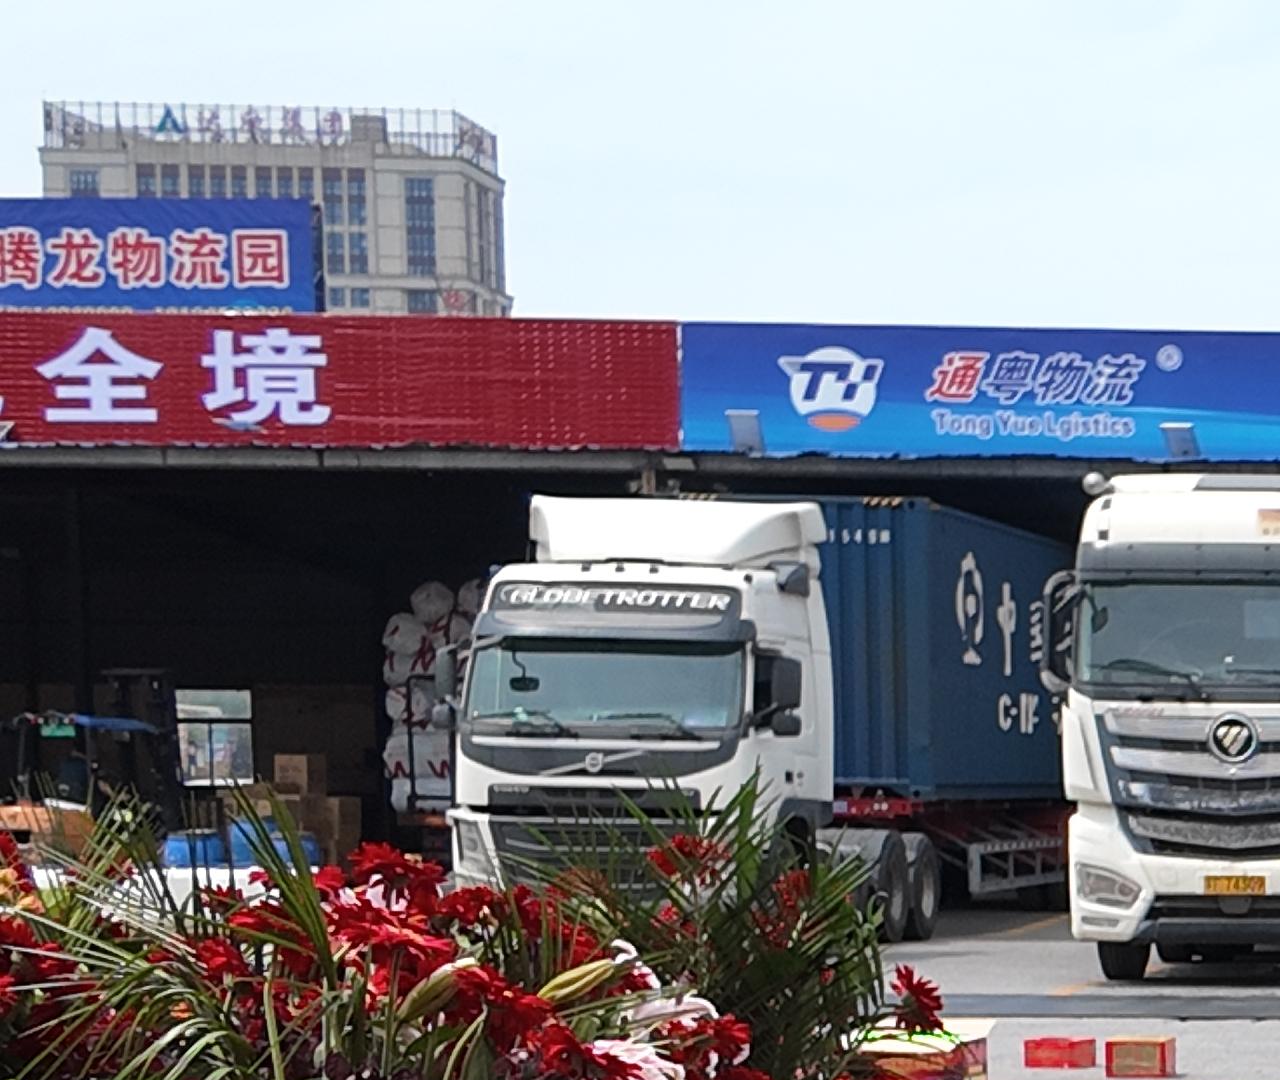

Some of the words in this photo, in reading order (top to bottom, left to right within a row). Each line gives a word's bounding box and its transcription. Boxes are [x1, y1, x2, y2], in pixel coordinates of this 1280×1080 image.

[0, 227, 290, 289] 腾龙物流园
[925, 351, 1146, 406] 通粤物流
[932, 409, 993, 440] Tong
[996, 409, 1041, 437] Yue
